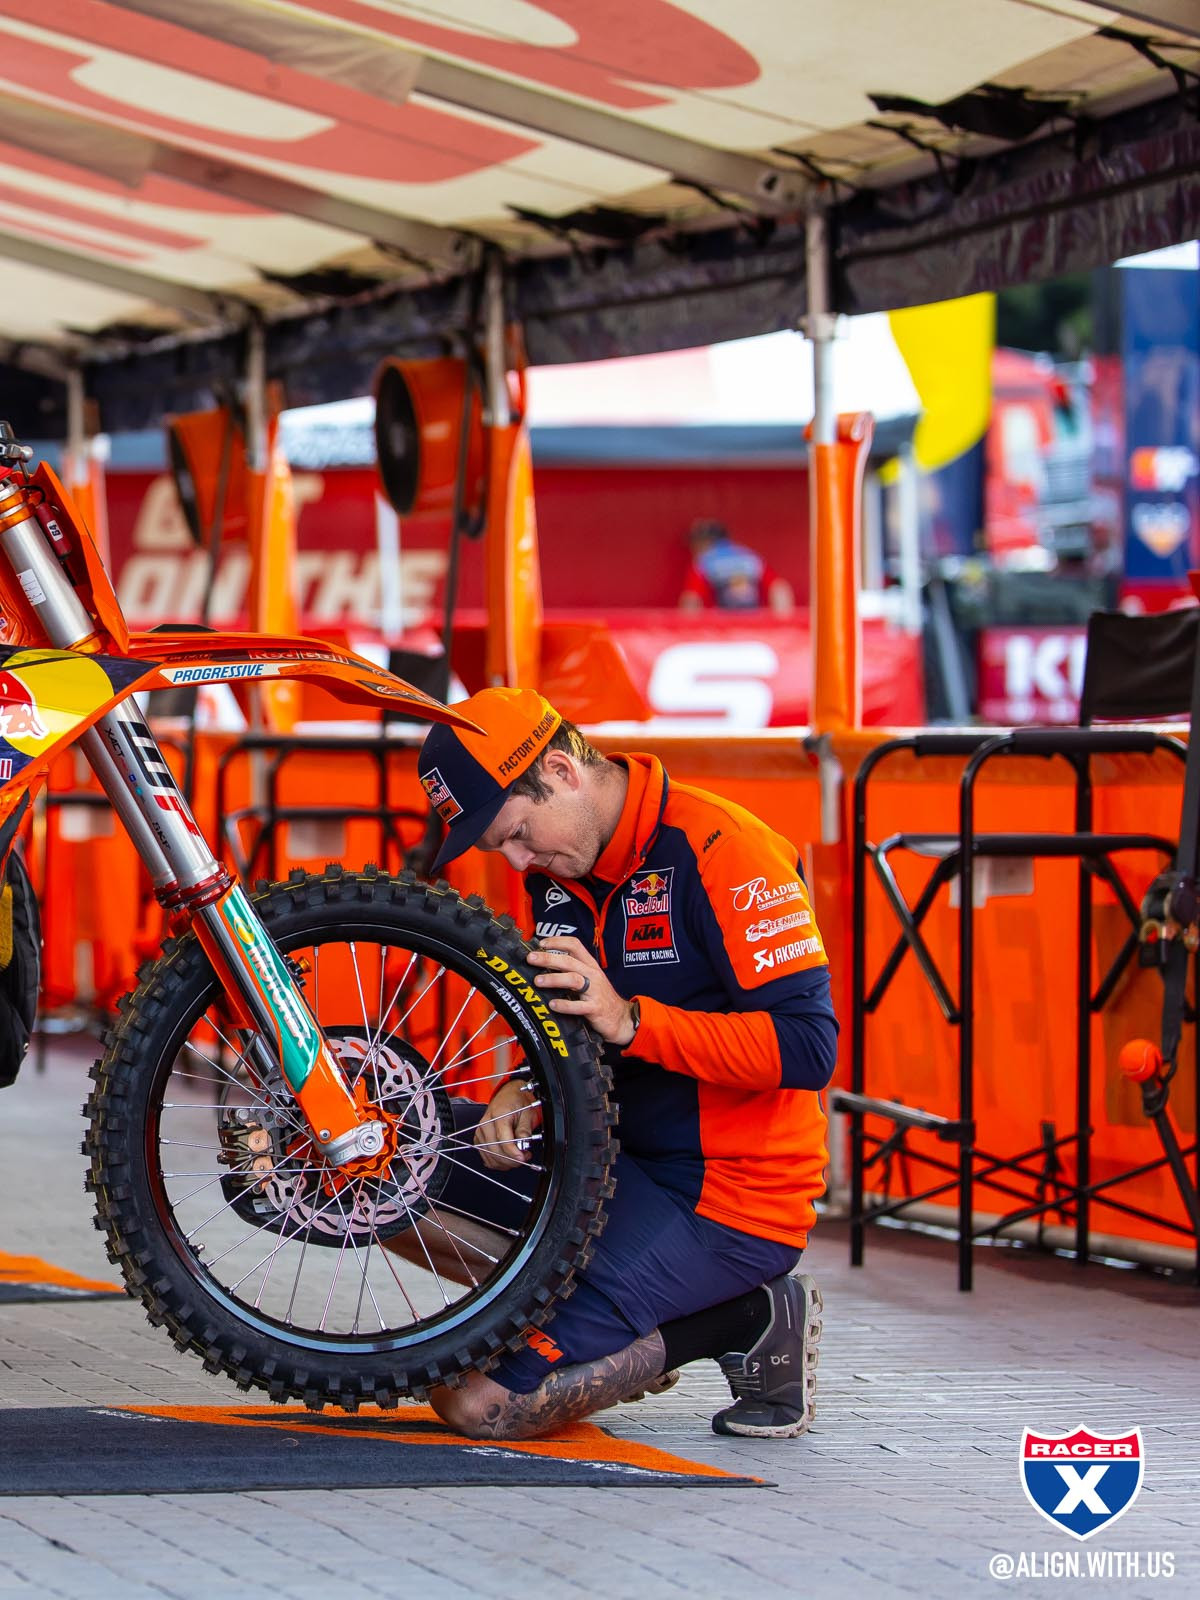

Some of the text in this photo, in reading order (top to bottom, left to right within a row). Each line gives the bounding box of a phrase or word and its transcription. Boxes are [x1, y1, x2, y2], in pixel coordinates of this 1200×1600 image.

[172, 664, 264, 682] PROGRESSIVE
[498, 711, 555, 777] FACTORY RACING
[625, 894, 668, 915] Red Bull
[631, 923, 664, 942] KTM
[625, 949, 675, 962] FACTORY RACING
[485, 955, 569, 1057] DUNLOP
